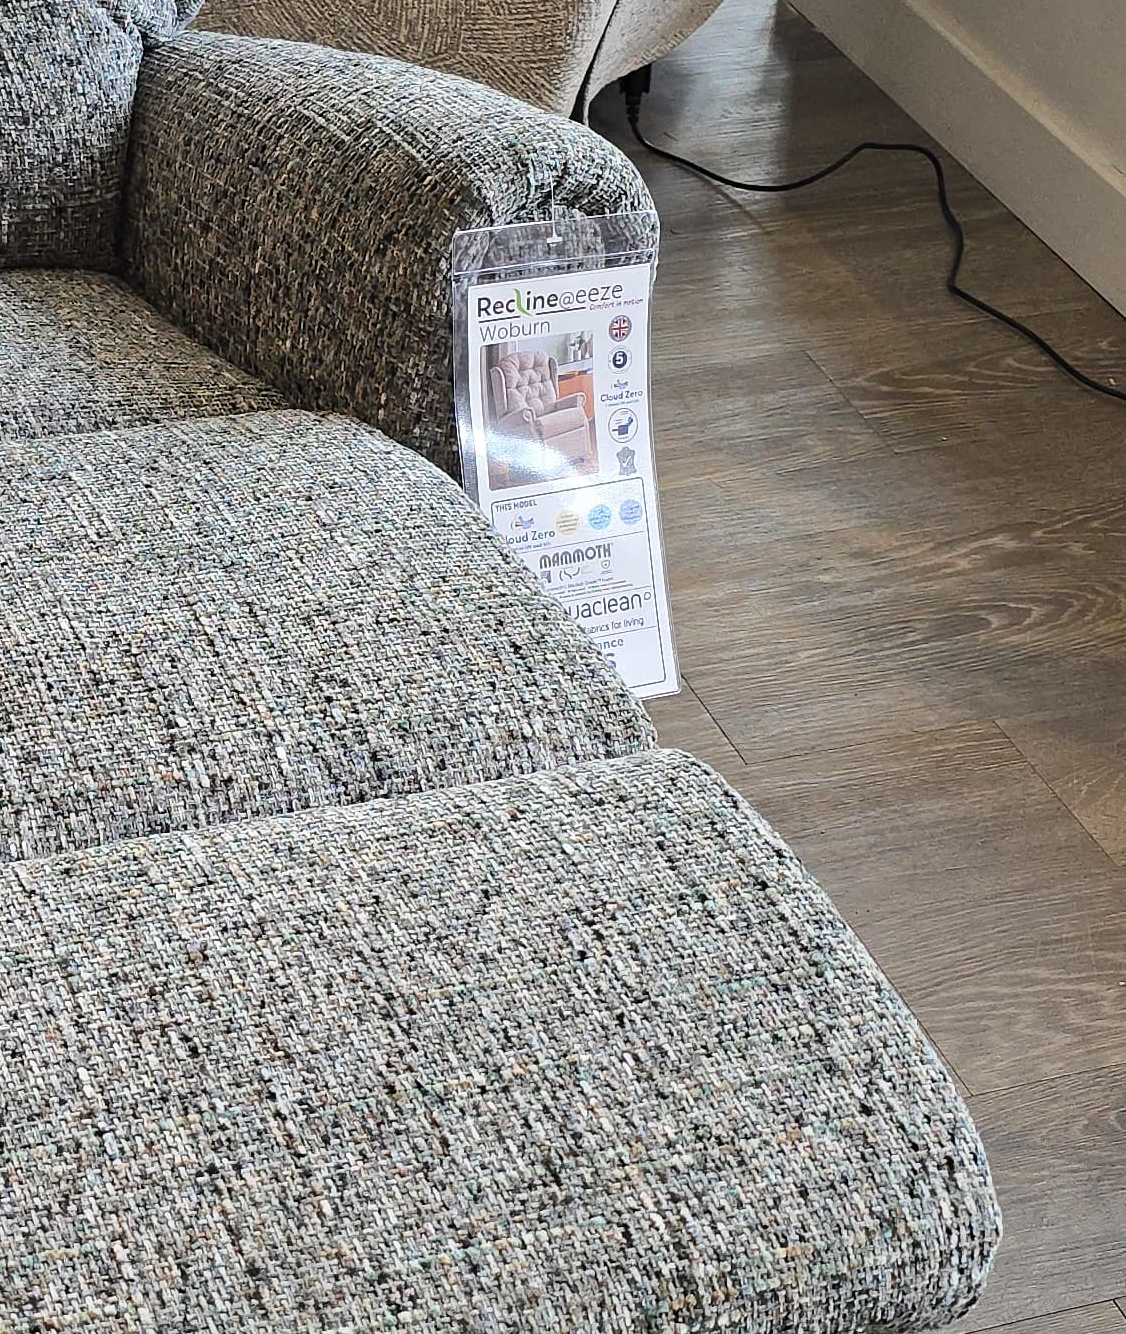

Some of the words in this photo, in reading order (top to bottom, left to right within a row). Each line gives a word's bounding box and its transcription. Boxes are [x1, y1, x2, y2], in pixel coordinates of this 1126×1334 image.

[479, 320, 551, 342] Woburn
[616, 352, 624, 365] 5
[600, 391, 624, 402] Cloud
[625, 390, 643, 399] Zero
[495, 503, 513, 513] THIS
[513, 499, 538, 509] MODEL
[505, 531, 529, 545] loud
[531, 529, 556, 541] Zero
[539, 543, 611, 568] MAMMOTH
[612, 621, 621, 629] for
[623, 617, 644, 628] living
